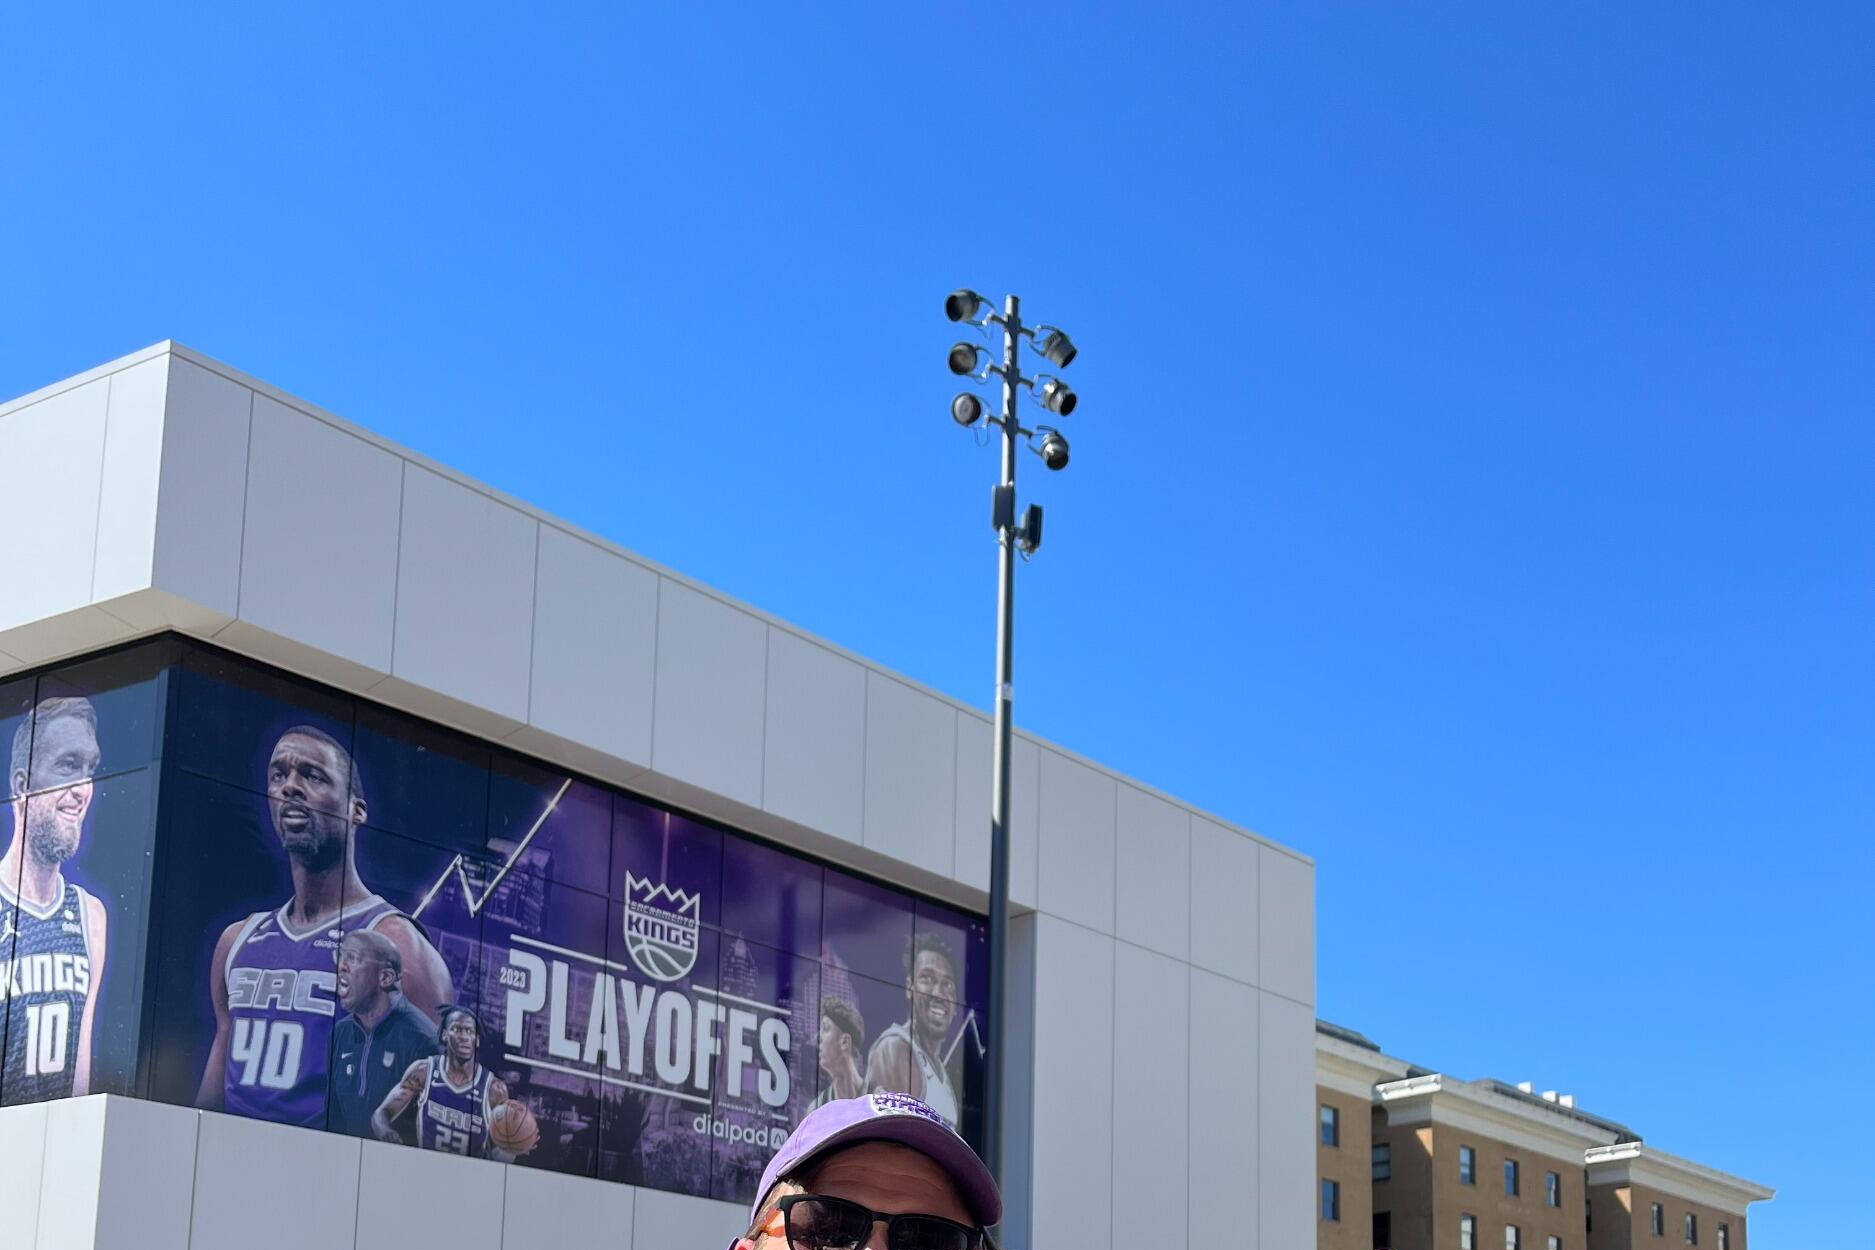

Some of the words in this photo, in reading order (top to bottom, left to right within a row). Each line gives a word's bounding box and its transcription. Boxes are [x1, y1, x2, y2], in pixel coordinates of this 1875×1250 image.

[627, 914, 696, 950] KINGS
[630, 901, 696, 929] SACRAMENTO
[0, 953, 91, 999] KINGS
[228, 967, 337, 1017] SAC
[500, 966, 526, 988] 2023
[25, 1001, 69, 1076] 10
[505, 948, 791, 1107] PLAYOFFS
[231, 1018, 304, 1090] 40
[428, 1099, 482, 1134] SAC
[693, 1113, 769, 1147] dialpad
[435, 1124, 470, 1155] 23
